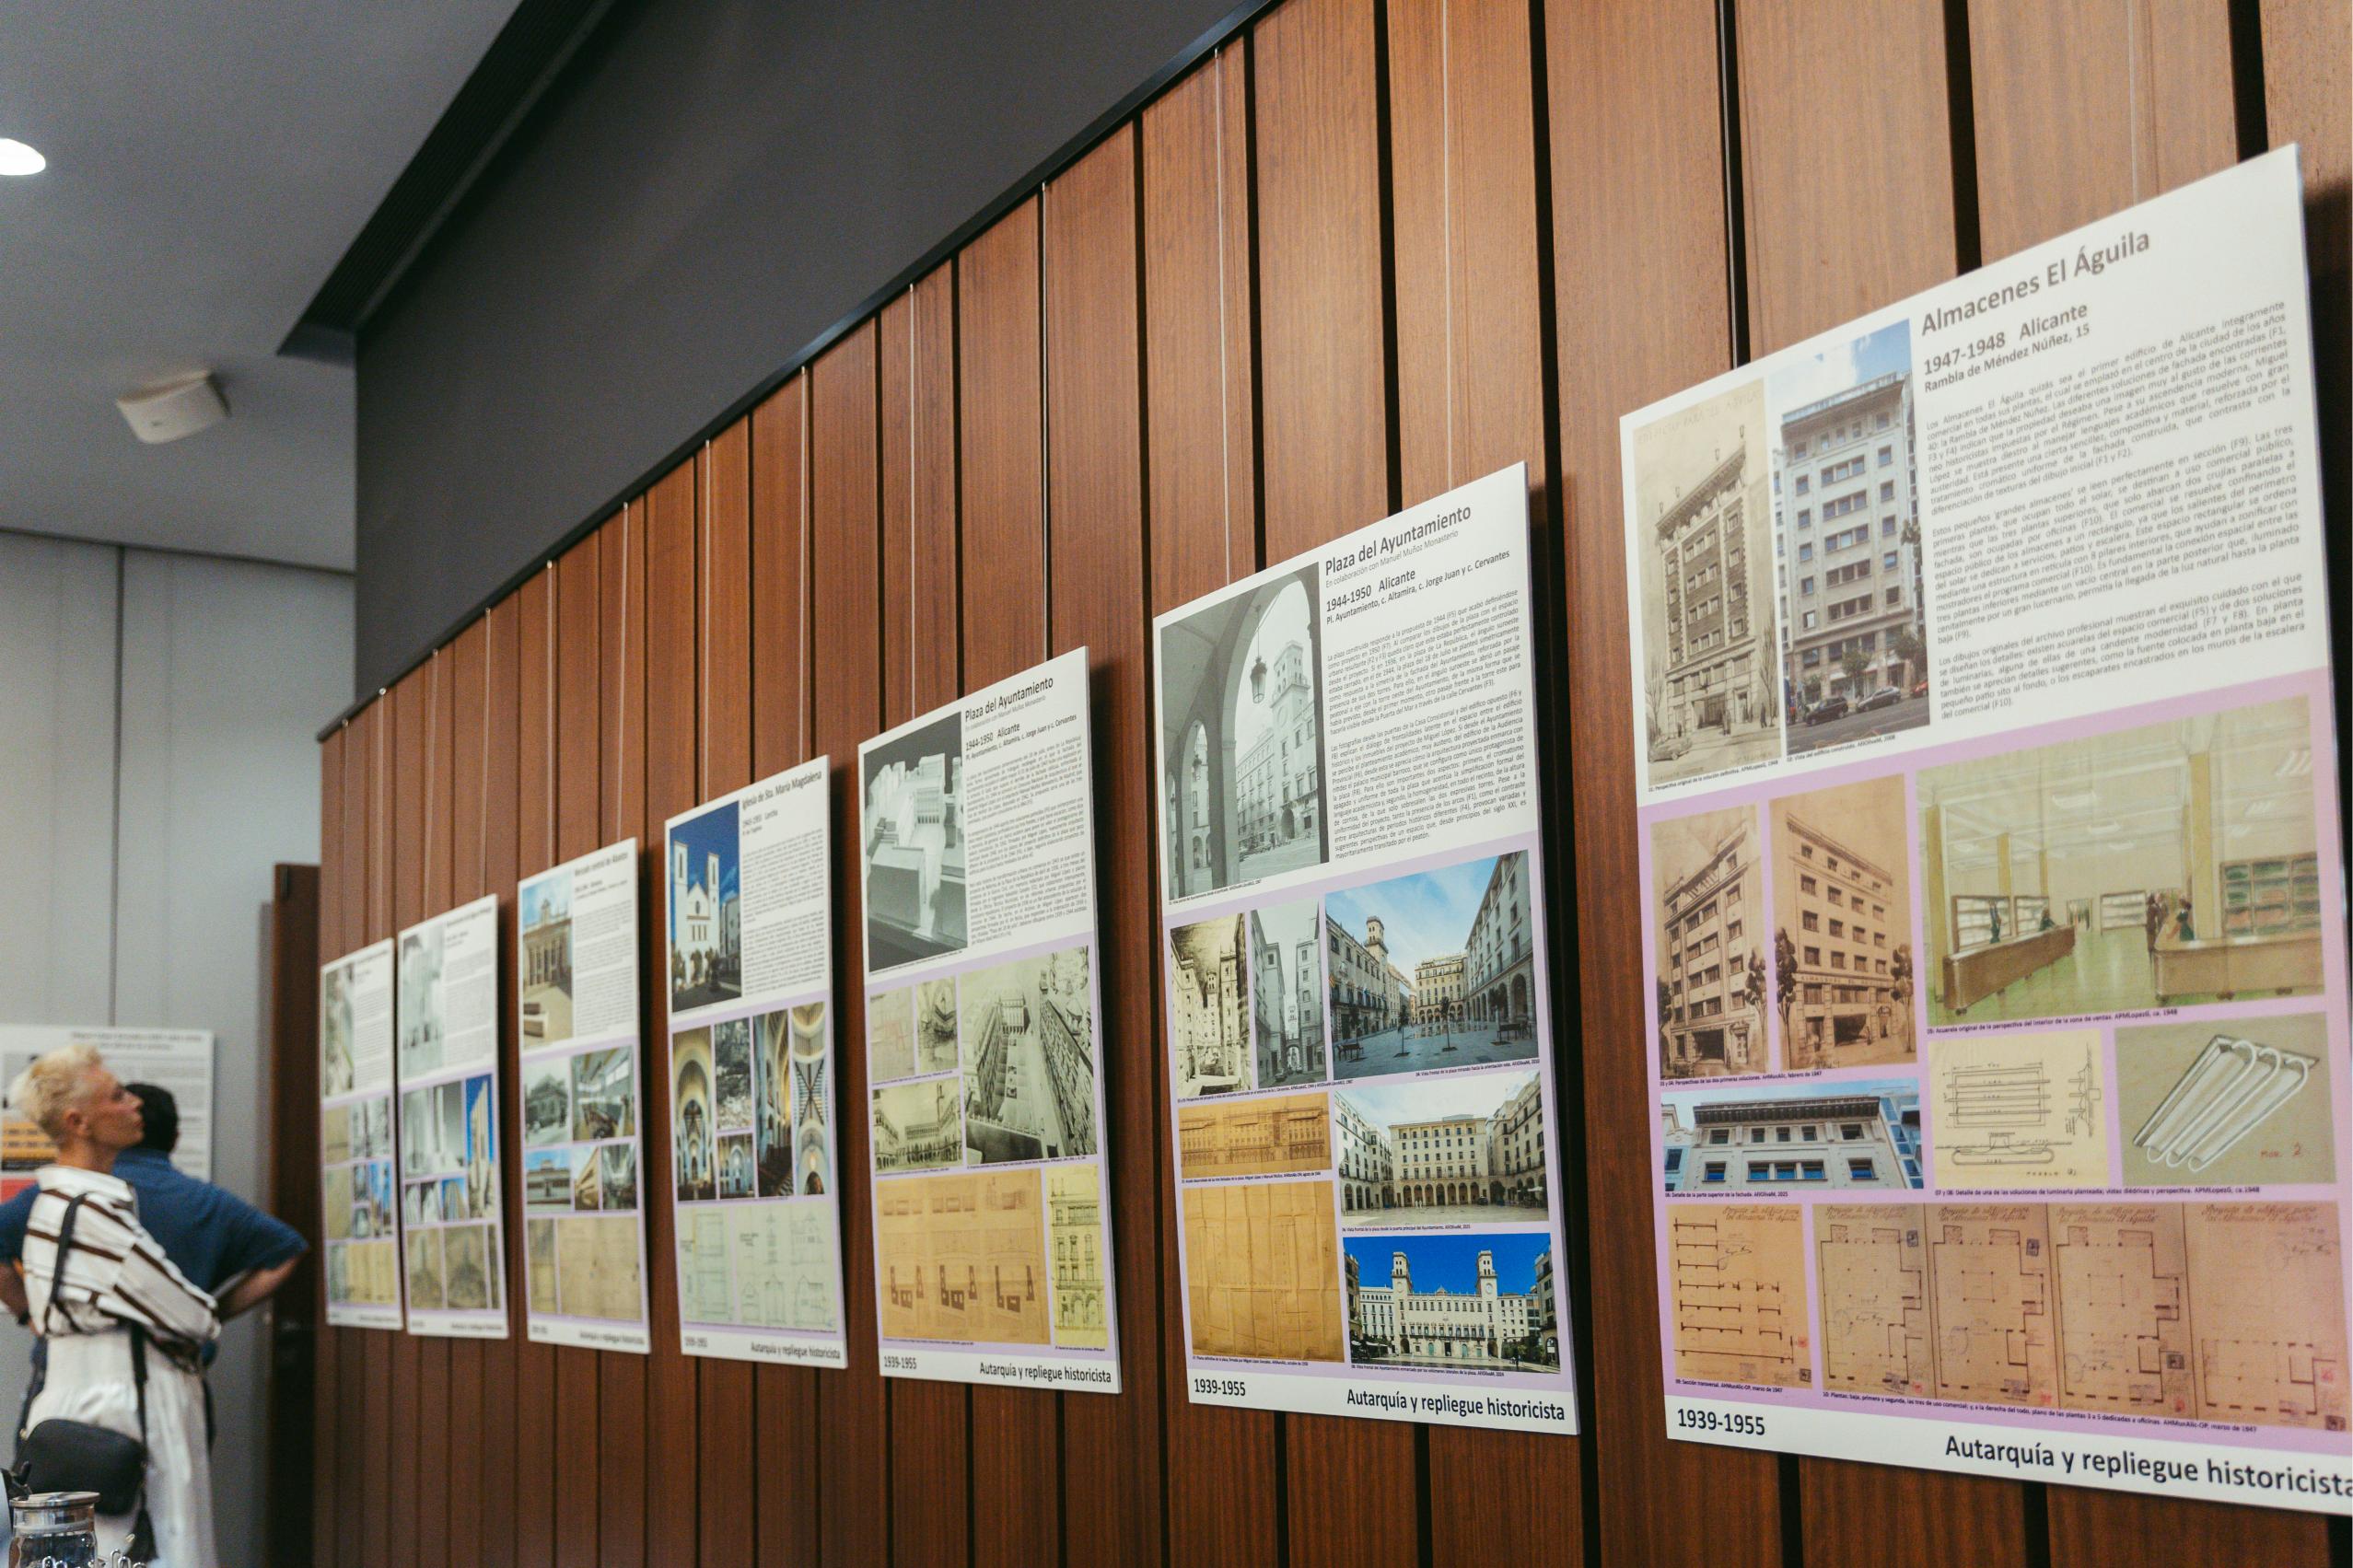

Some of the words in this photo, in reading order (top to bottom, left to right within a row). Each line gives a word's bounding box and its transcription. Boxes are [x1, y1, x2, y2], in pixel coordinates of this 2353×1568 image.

[1922, 276, 2040, 336] Almacenes
[2048, 259, 2067, 287] El
[2074, 232, 2149, 277] Águila
[1924, 331, 2006, 376] 1947-1948
[2020, 305, 2088, 341] Alicante
[1925, 370, 1964, 393] Rambla
[1967, 364, 1981, 377] de
[1985, 348, 2029, 371] Méndez
[2033, 333, 2072, 354] Núñez,
[2076, 323, 2090, 338] 15
[1325, 554, 1356, 576] Plaza
[1358, 540, 1377, 562] del
[1380, 507, 1471, 554] Ayuntamiento
[1326, 580, 1333, 588] En
[1334, 566, 1368, 585] colaboración
[1369, 562, 1380, 571] con
[1380, 551, 1402, 566] Manuel
[1404, 544, 1423, 558] Muñoz
[1424, 530, 1458, 549] Monasterio
[1326, 586, 1372, 612] 1944-1950
[1379, 570, 1415, 592] Alicante
[1335, 600, 1380, 621] Ayuntamiento,
[1388, 587, 1417, 602] Altamira,
[1426, 575, 1443, 587] Jorge
[1445, 569, 1461, 581] Juan
[1462, 567, 1466, 575] y
[1474, 551, 1509, 569] Cervantes
[1940, 685, 1971, 697] también
[1984, 676, 2016, 689] aprecian
[2019, 668, 2049, 679] detalles
[2052, 657, 2098, 672] sugerentes,
[2101, 652, 2124, 661] como
[2137, 642, 2165, 654] fuente
[2168, 632, 2207, 646] colocada
[2225, 622, 2254, 635] planta
[2257, 616, 2277, 627] baja
[1949, 663, 1978, 674] diseñan
[2027, 645, 2055, 656] existen
[2057, 635, 2095, 648] acuarelas
[2113, 622, 2145, 635] espacio
[2147, 610, 2189, 627] comercial
[2253, 587, 2302, 603] soluciones
[1998, 663, 2023, 674] alguna
[2043, 655, 2061, 663] ellas
[2101, 636, 2139, 650] candente
[2145, 621, 2197, 640] modernidad
[2274, 598, 2302, 612] planta
[1940, 696, 1973, 710] pequeño
[1975, 691, 1995, 703] patio
[1997, 688, 2011, 696] sito
[2072, 664, 2121, 679] escaparates
[2124, 652, 2175, 668] encastrados
[2207, 639, 2236, 650] muros
[2266, 624, 2304, 637] escalera
[965, 707, 984, 723] Plaza
[985, 698, 996, 714] del
[998, 678, 1054, 709] Ayuntamiento
[1954, 702, 1990, 716] comercial
[884, 1355, 916, 1370] 1939-1955
[979, 1362, 1017, 1378] Autarquía
[1019, 1367, 1023, 1379] y
[1025, 1365, 1063, 1382] repliegue
[1065, 1366, 1111, 1383] historicista
[1194, 1378, 1246, 1397] 1939-1955
[1346, 1388, 1407, 1411] Autarquía
[1410, 1397, 1418, 1412] y
[1422, 1394, 1484, 1417] repliegue
[1487, 1397, 1565, 1421] historicista
[1677, 1409, 1765, 1436] 1939-1955
[1945, 1436, 2055, 1468] Autarquía
[2061, 1452, 2075, 1472] y
[2083, 1451, 2199, 1482] repliegue
